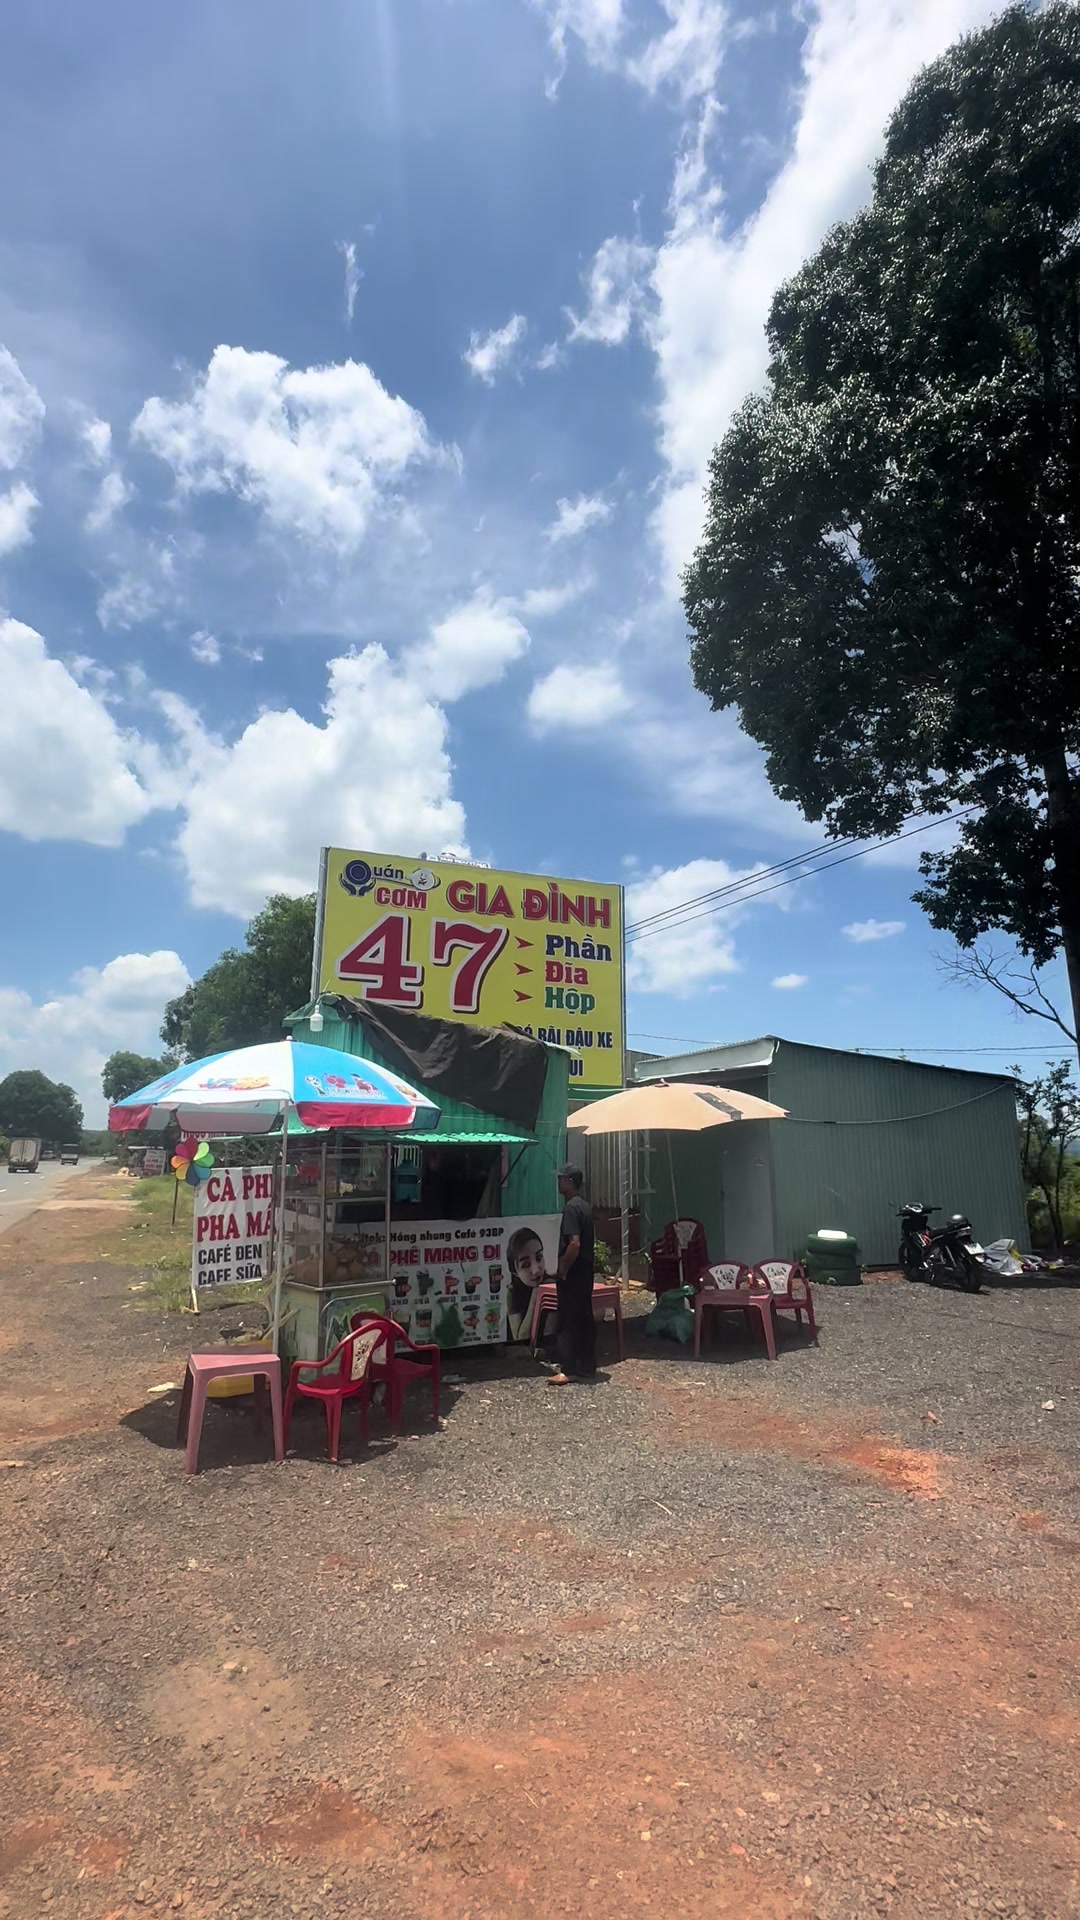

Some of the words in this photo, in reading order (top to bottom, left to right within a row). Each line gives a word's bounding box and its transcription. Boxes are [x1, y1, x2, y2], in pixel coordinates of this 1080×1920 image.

[342, 860, 404, 890] Quán
[376, 886, 428, 911] CƠM
[446, 880, 514, 918] GIA
[521, 882, 612, 928] ĐÌNH
[545, 933, 613, 962] Phần
[336, 913, 508, 1014] 47
[545, 961, 589, 985] Đĩa
[545, 986, 596, 1015] Hộp
[538, 1025, 561, 1045] BÃI
[565, 1026, 593, 1050] ĐẬU
[597, 1031, 613, 1048] XE
[206, 1169, 237, 1203] CÀ
[242, 1173, 273, 1200] PH
[197, 1213, 241, 1243] PHA
[198, 1244, 231, 1265] CAFÉ
[236, 1244, 262, 1261] ĐEN
[424, 1245, 479, 1266] MANG
[483, 1244, 502, 1262] ĐI
[236, 1263, 262, 1280] SỮA
